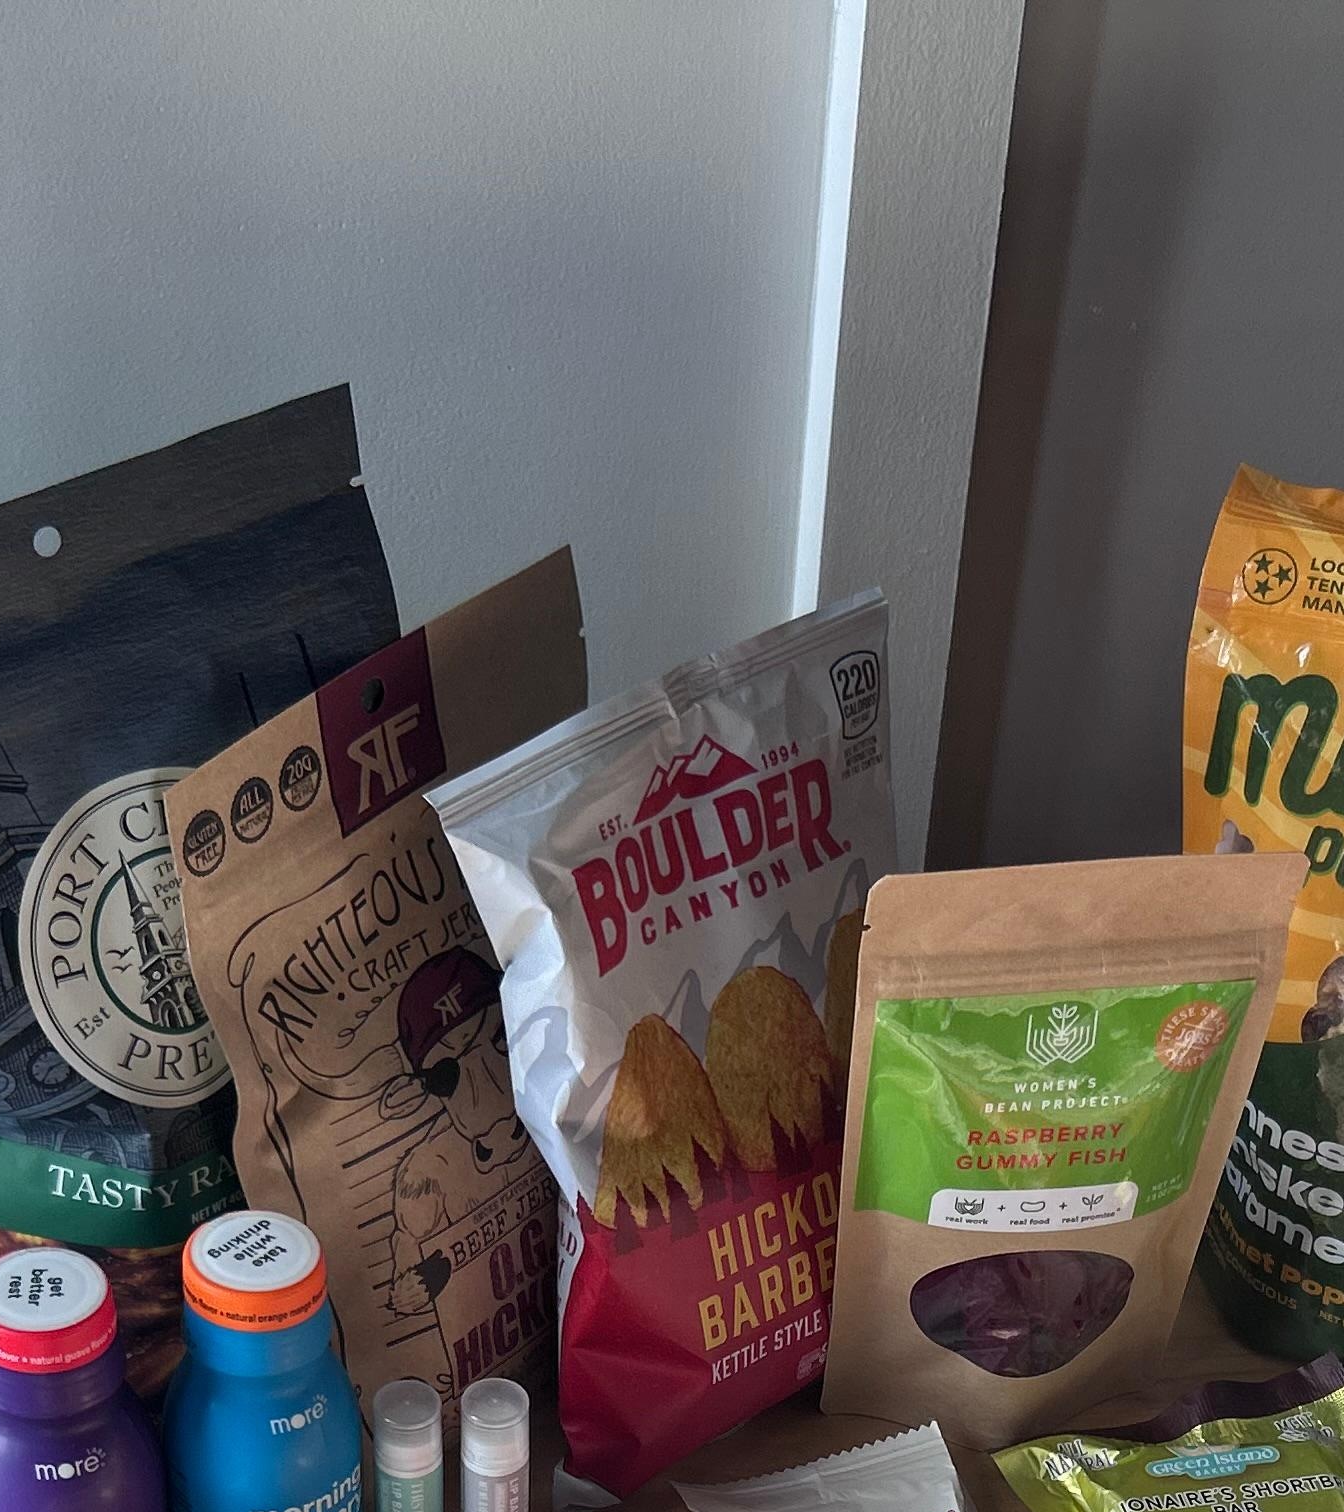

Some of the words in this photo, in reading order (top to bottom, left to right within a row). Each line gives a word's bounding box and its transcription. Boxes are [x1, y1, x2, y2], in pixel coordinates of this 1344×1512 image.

[837, 660, 876, 701] 220
[240, 786, 263, 815] ALL
[598, 817, 629, 841] EST.
[761, 741, 799, 770] 1994
[195, 842, 221, 869] FREE
[572, 757, 846, 979] BOULDER
[48, 833, 109, 989] PORT
[640, 858, 791, 946] CANYON
[258, 838, 445, 1043] RIGHTEOUS
[347, 929, 430, 992] CRAFT
[73, 1006, 112, 1041] Est
[984, 1101, 1032, 1114] BEAN
[1041, 1095, 1122, 1110] PROJECT
[1014, 1077, 1097, 1094] WOMEN'S
[967, 1123, 1125, 1146] RASPBERRY
[956, 1152, 1058, 1171] GUMMY
[1068, 1148, 1127, 1167] FISH
[48, 1162, 177, 1212] TASTY
[207, 1220, 271, 1259] drinking
[449, 1208, 507, 1268] BEEF
[707, 1171, 838, 1282] HICKO
[234, 1234, 276, 1261] while
[252, 1246, 287, 1267] take
[8, 1276, 22, 1299] rest
[28, 1269, 48, 1306] better
[48, 1277, 64, 1297] get
[711, 1335, 769, 1385] KETTLE
[773, 1307, 823, 1352] STYLE
